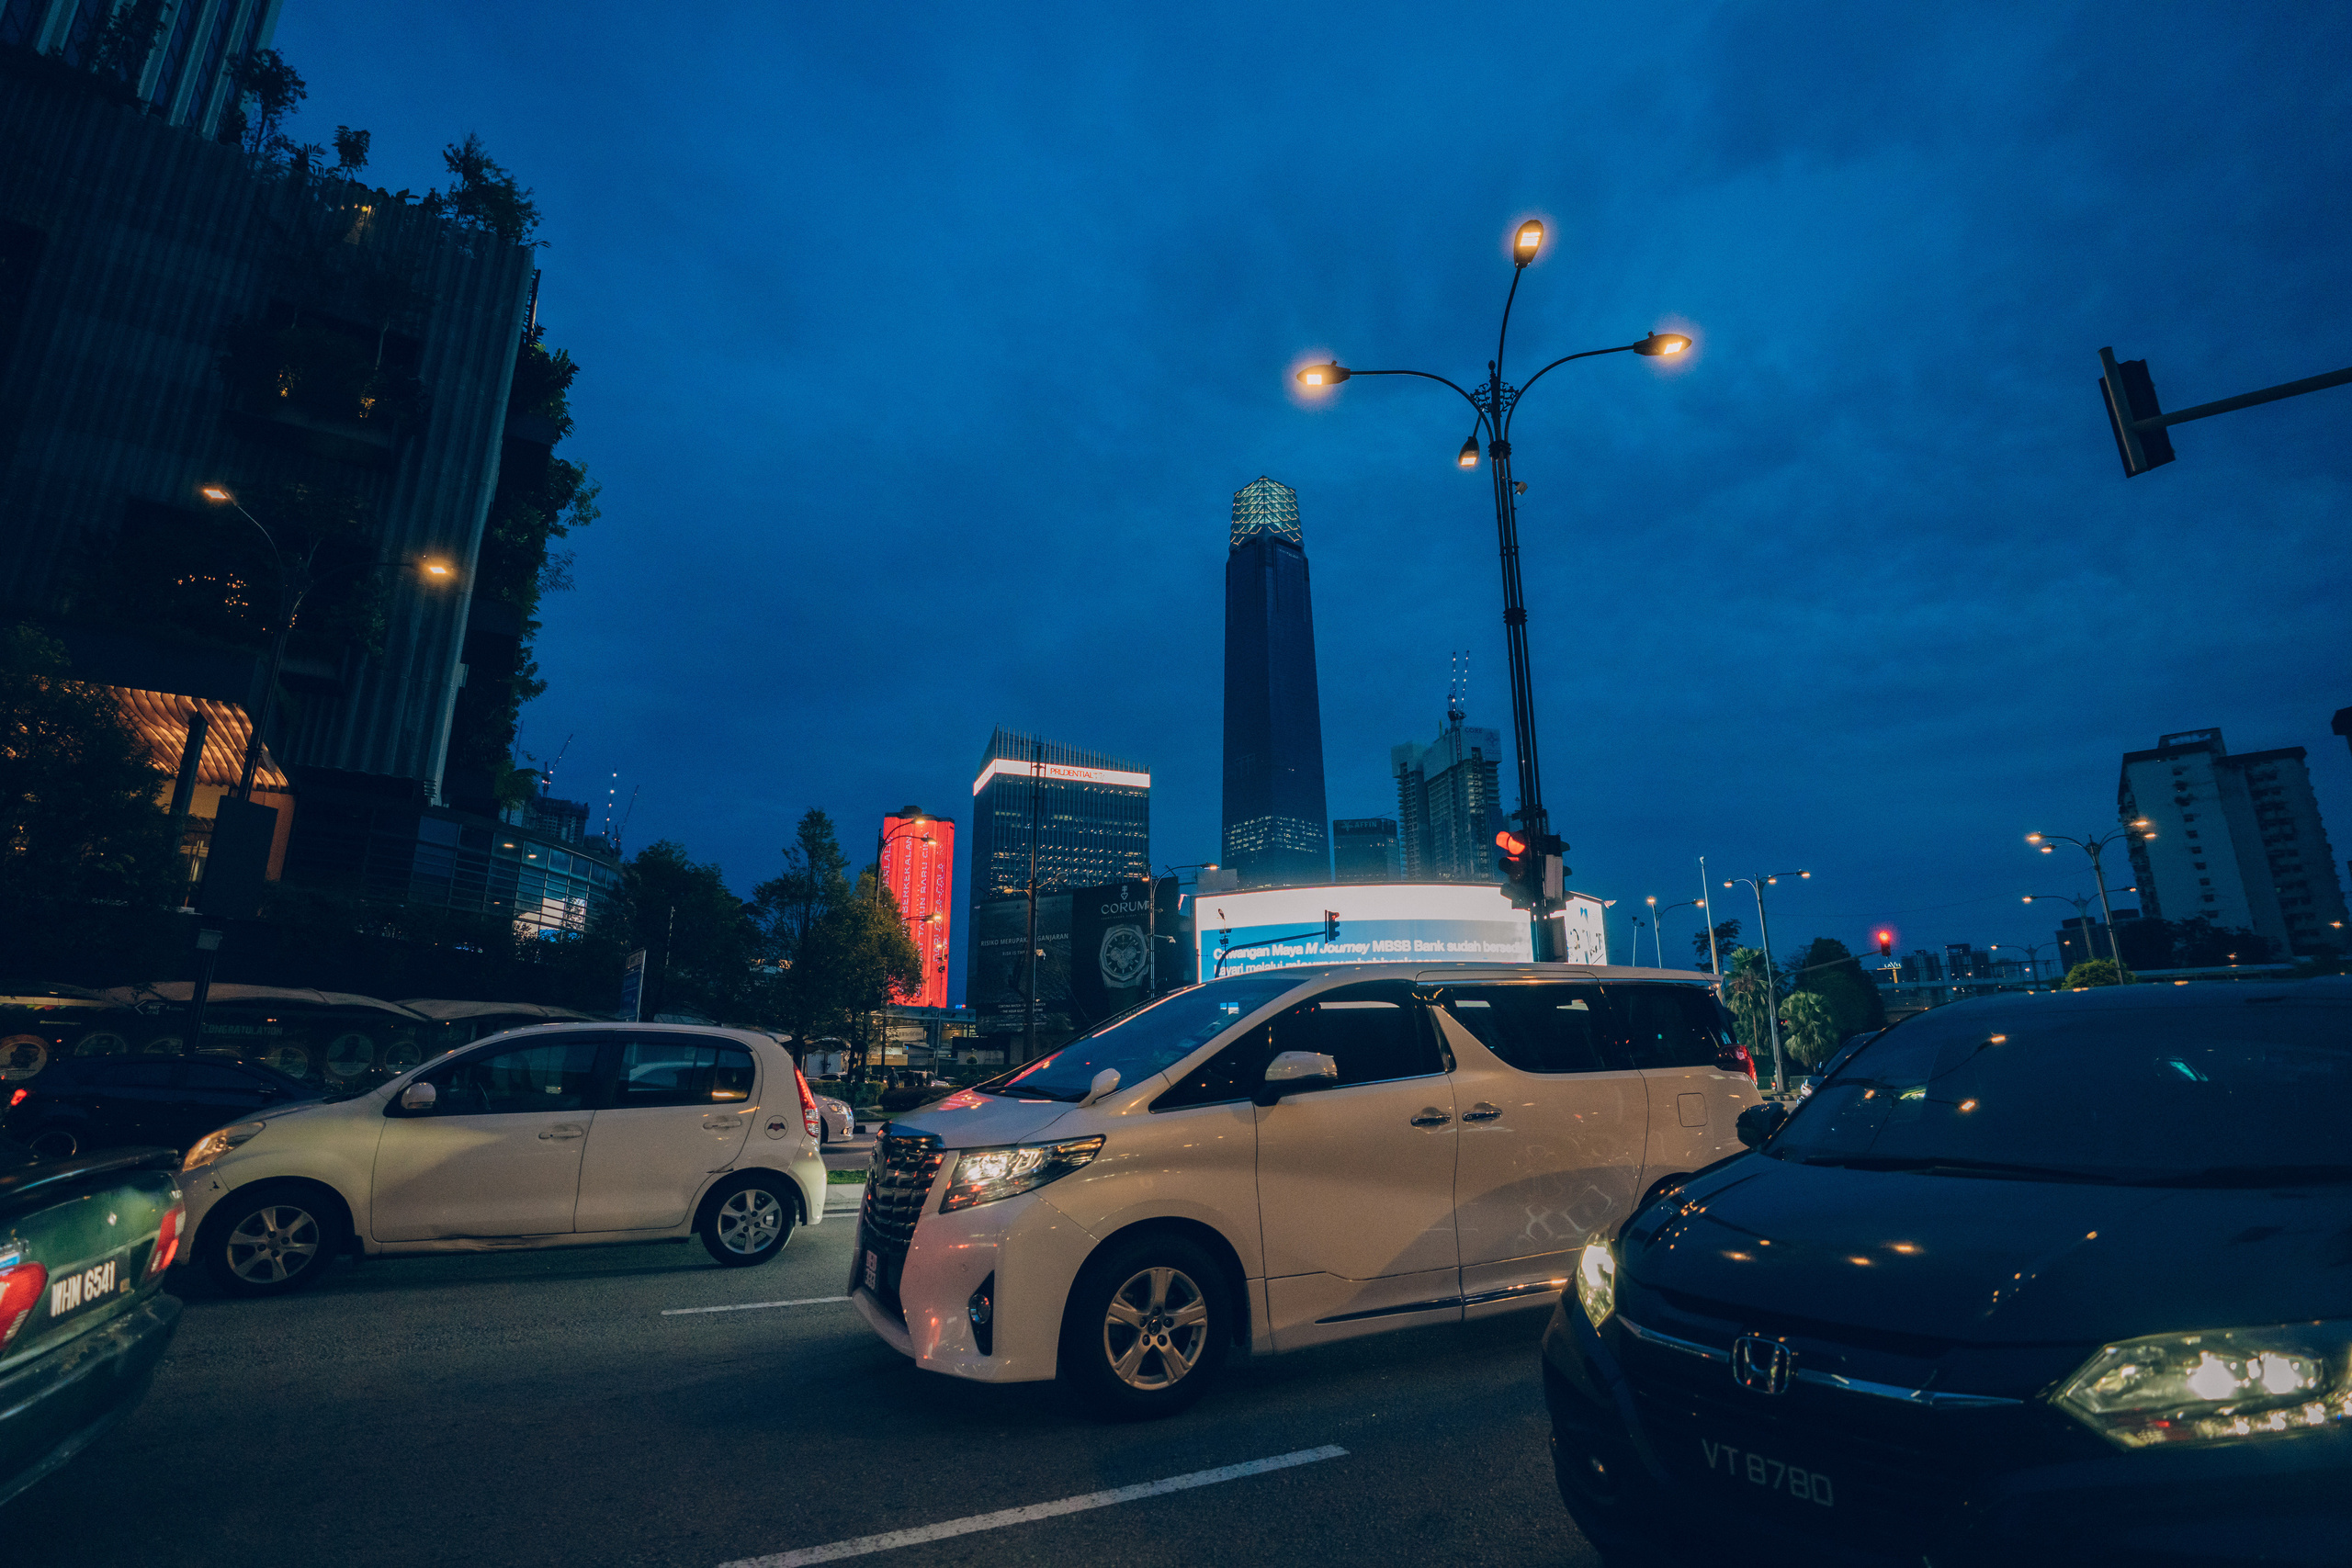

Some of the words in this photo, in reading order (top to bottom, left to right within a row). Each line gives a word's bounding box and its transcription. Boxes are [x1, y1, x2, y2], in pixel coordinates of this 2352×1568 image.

[1050, 767, 1093, 779] PRUDENTIAL
[1101, 900, 1148, 915] CORUM
[980, 939, 999, 947] RISIKO
[1000, 937, 1028, 945] MERUPAK
[1037, 933, 1069, 942] GANJARAN
[1272, 944, 1303, 957] Maya
[1306, 942, 1318, 954] M
[1319, 942, 1370, 954] Journey
[1372, 940, 1411, 953] MBSB
[1414, 940, 1445, 953] Bank
[1446, 941, 1481, 953] sudah
[51, 1274, 82, 1317] WHM
[84, 1260, 115, 1302] 6541
[1702, 1438, 1739, 1475] VT
[1747, 1452, 1834, 1507] 8780
